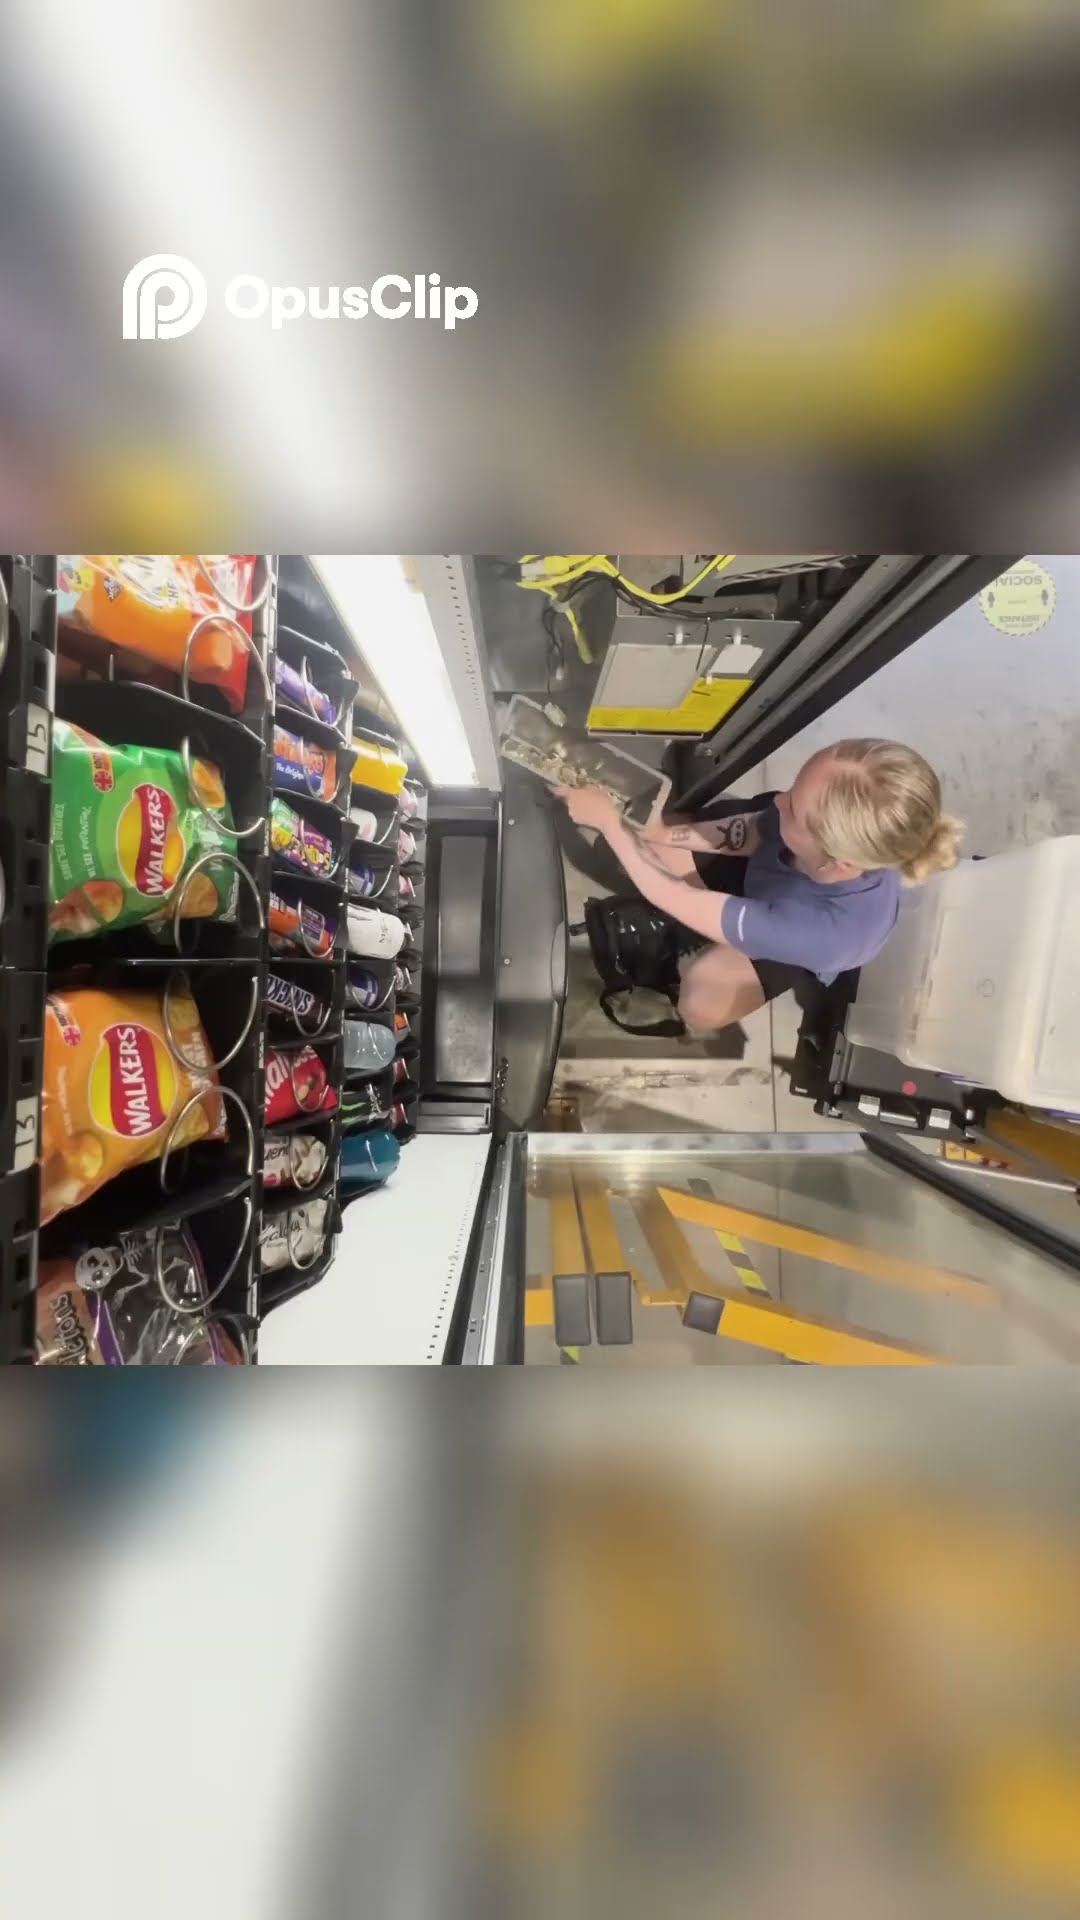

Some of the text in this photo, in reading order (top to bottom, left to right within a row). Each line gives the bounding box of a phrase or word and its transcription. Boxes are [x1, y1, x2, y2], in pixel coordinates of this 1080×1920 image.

[28, 723, 46, 755] 15
[144, 787, 165, 893] WALKERS
[117, 1027, 152, 1135] WALKERS
[16, 1114, 35, 1147] 13
[49, 1294, 87, 1366] letons
